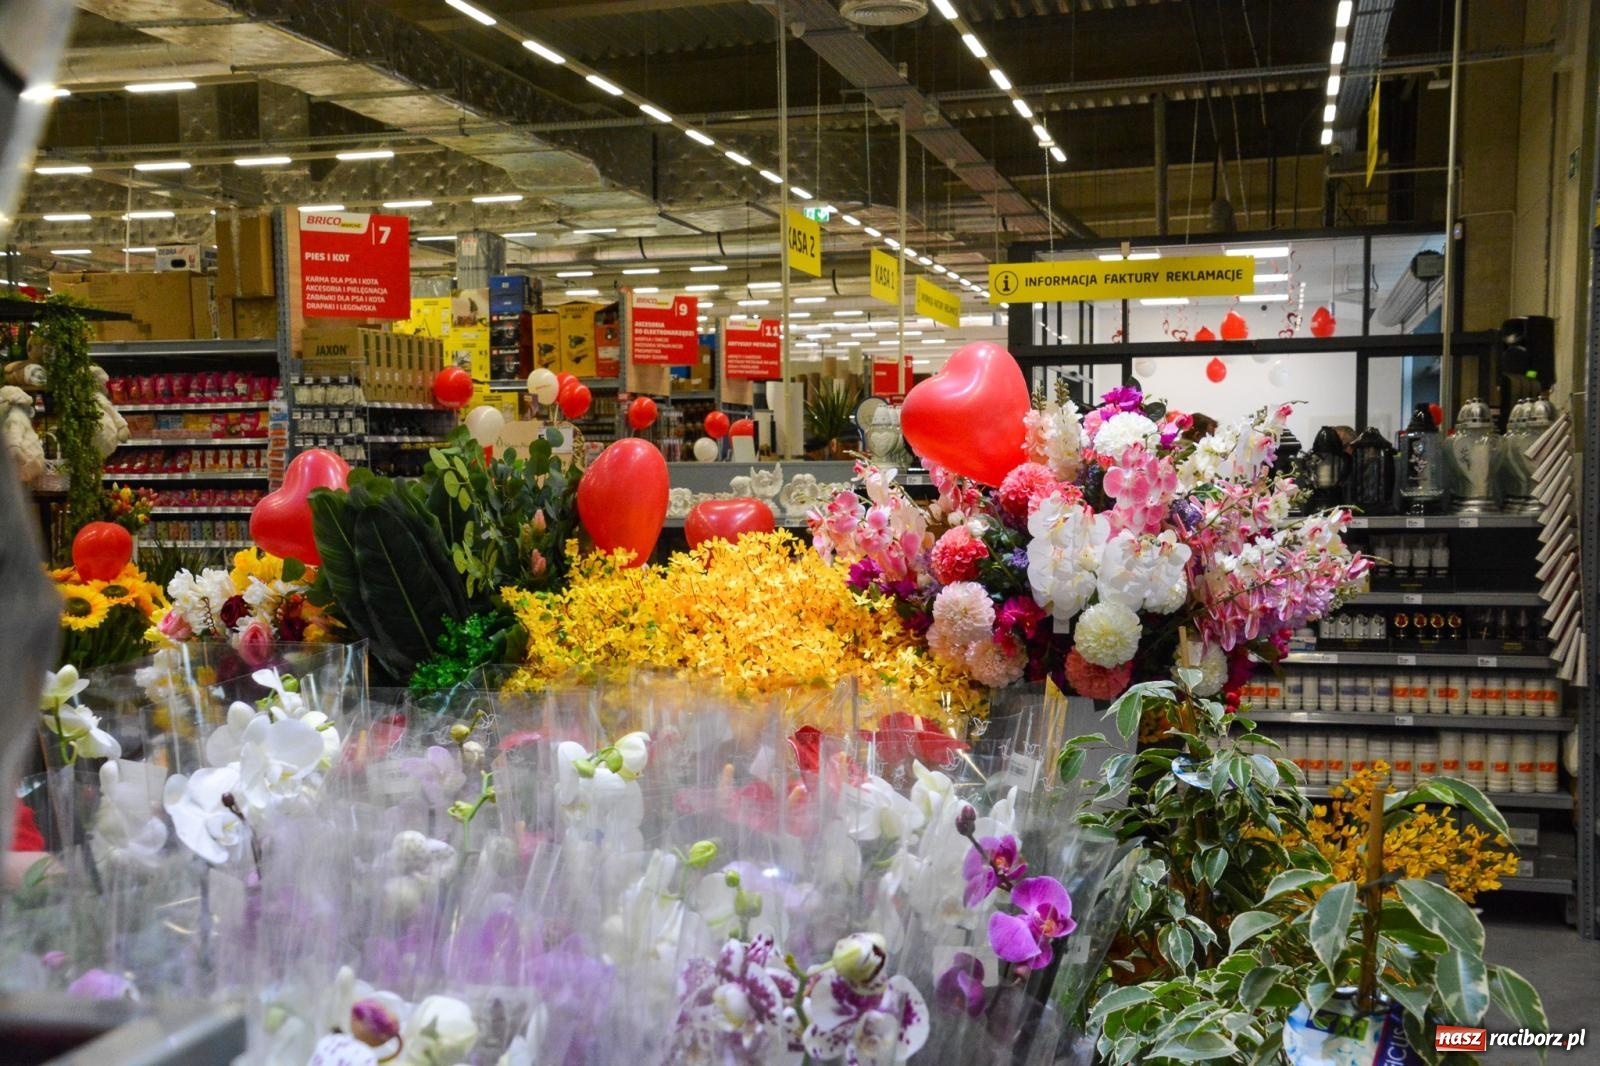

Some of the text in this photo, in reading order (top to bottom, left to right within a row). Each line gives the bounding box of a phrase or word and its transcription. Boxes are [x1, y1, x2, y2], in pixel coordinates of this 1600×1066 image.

[306, 215, 342, 226] BRICO
[378, 225, 392, 245] 7
[810, 235, 815, 258] 2
[304, 251, 325, 261] PIES
[332, 253, 350, 263] KOT
[305, 275, 329, 284] KARMA
[330, 276, 343, 284] DLA
[344, 276, 357, 285] PSA
[362, 278, 378, 286] KOTA
[874, 264, 890, 288] KASA
[1025, 268, 1243, 289] INFORMACJA FAKTURY REKLAMACJE
[305, 284, 341, 293] AKCESORIA
[346, 286, 387, 295] PIELĘGNACJA
[306, 294, 336, 302] ZABAWKI
[337, 294, 349, 302] DLA
[351, 295, 363, 303] PSA
[368, 296, 385, 304] KOTA
[306, 303, 335, 311] DRAPAKI
[340, 304, 376, 312] LEGOWISKA
[678, 303, 688, 316] 9
[765, 325, 779, 337] 11
[316, 344, 347, 356] JAXON
